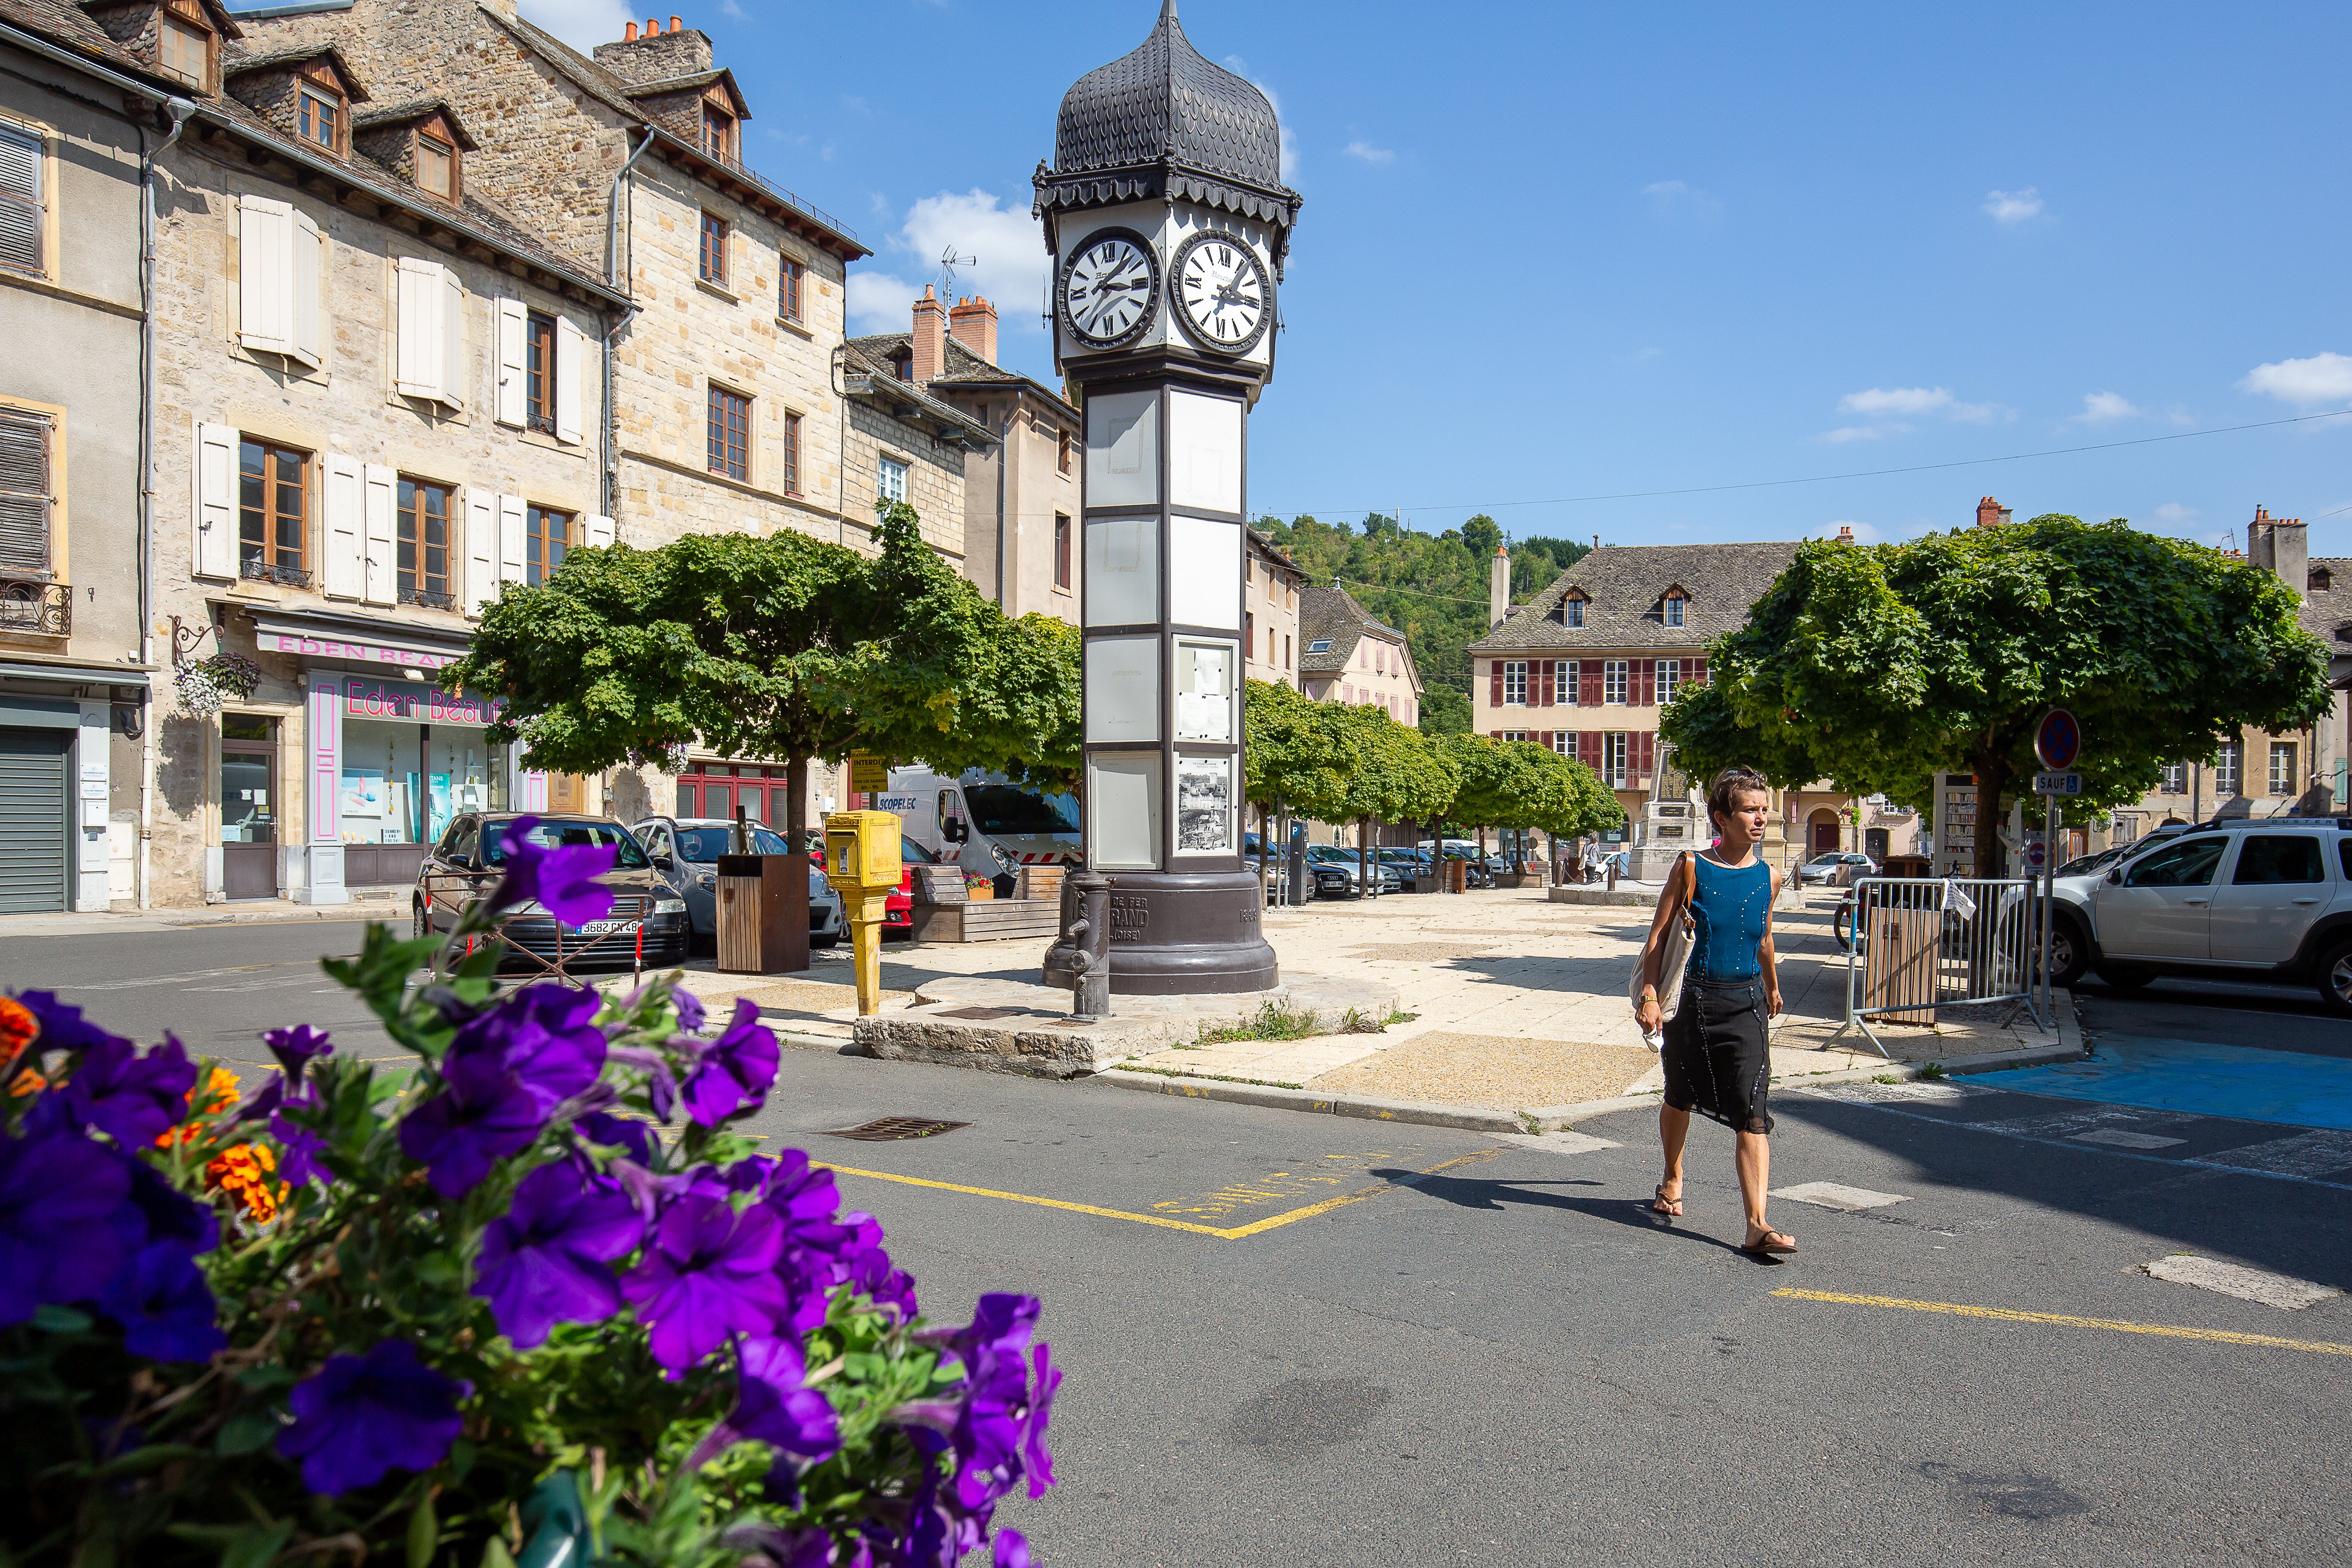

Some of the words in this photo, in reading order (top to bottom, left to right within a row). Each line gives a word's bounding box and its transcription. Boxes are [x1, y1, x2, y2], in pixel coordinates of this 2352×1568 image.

[278, 636, 366, 659] EDEN
[348, 682, 420, 718] Eden
[429, 689, 502, 724] Beaut
[2040, 777, 2065, 789] SAUF
[877, 798, 916, 810] SCOPELEC
[1111, 897, 1124, 908] DE
[1128, 897, 1147, 908] FER
[584, 923, 608, 932] 3682
[626, 923, 637, 932] 48
